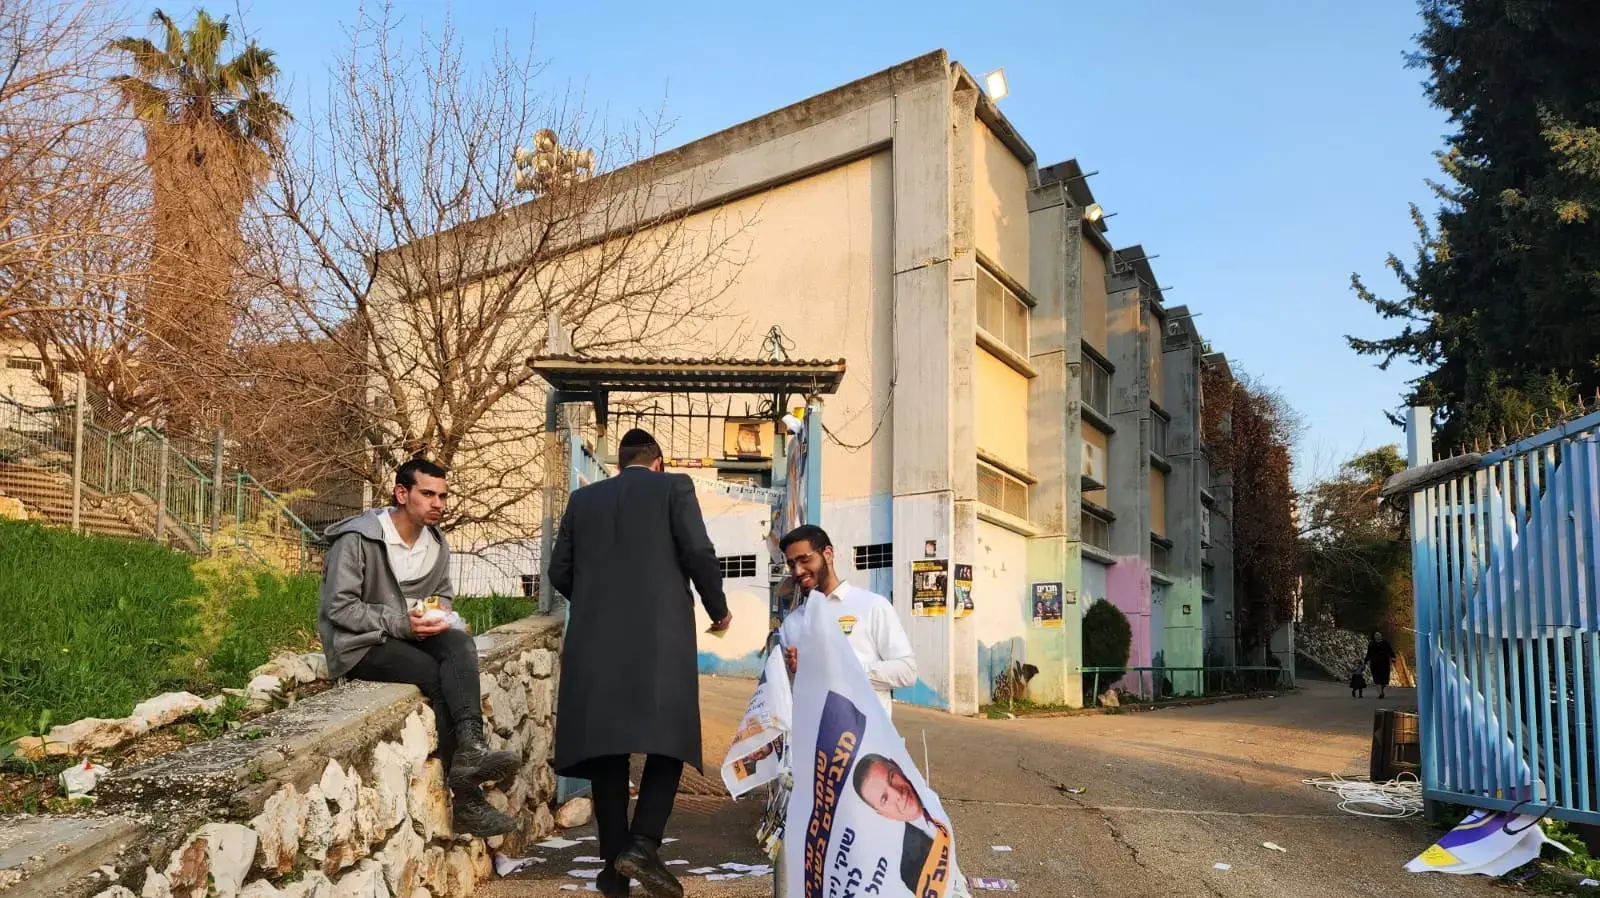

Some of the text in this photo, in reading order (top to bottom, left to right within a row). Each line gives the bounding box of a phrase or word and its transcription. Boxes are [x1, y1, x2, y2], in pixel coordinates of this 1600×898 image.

[809, 750, 828, 838] שומרים
[822, 731, 857, 832] מצביעים
[834, 827, 856, 870] שוקי
[864, 857, 888, 895] מחל
